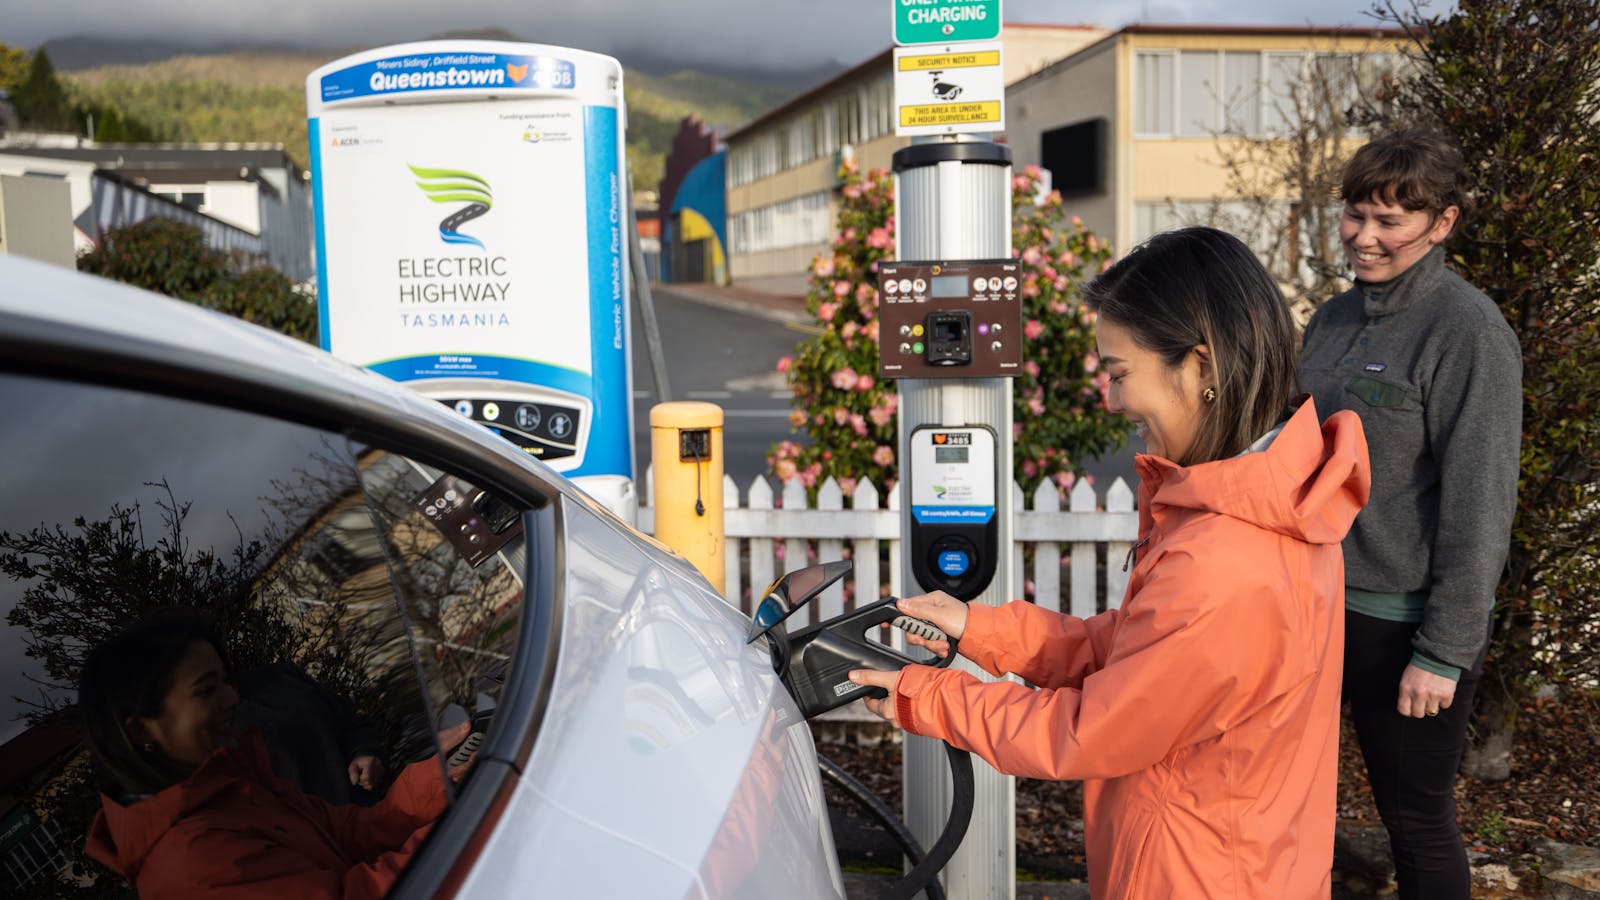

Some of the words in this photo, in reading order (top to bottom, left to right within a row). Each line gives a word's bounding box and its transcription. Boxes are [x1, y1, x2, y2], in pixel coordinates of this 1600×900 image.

[907, 4, 987, 25] CHARGING
[433, 55, 469, 66] Driffield
[469, 53, 496, 65] Street
[917, 56, 951, 67] SECURITY
[952, 55, 977, 65] NOTICE
[370, 66, 505, 91] Queenstown
[908, 116, 917, 124] 24
[918, 115, 937, 123] HOUR
[938, 112, 988, 122] SURVEILLANCE
[914, 107, 930, 115] THIS
[931, 105, 950, 114] AREA
[951, 105, 958, 113] IS
[959, 104, 983, 113] UNDER
[609, 171, 619, 223] Charger
[610, 227, 620, 253] Fast
[398, 256, 508, 278] ELECTRIC
[611, 256, 621, 300] Vehicle
[399, 282, 511, 303] HIGHWAY
[401, 312, 510, 328] TASMANIA
[612, 303, 623, 349] Electric
